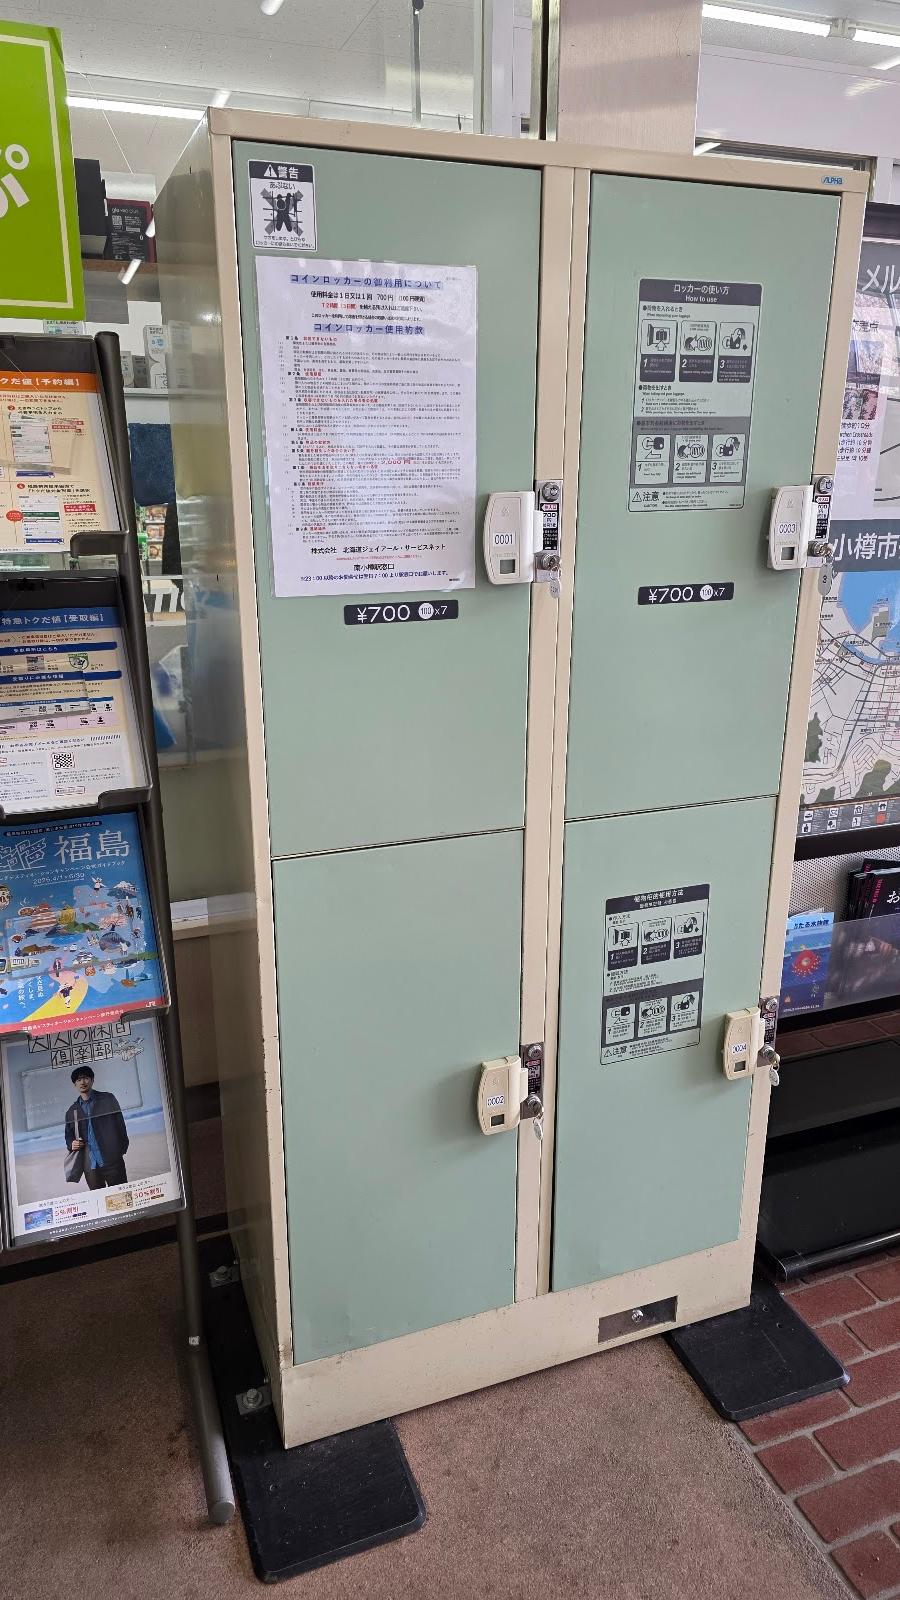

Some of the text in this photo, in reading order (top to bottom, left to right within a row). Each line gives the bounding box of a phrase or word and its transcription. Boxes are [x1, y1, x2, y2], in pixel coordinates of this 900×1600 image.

[278, 166, 299, 180] 警告
[823, 176, 843, 184] ALPHA
[269, 182, 296, 190] あぶない
[290, 274, 442, 290] コインロッカーの御利用について
[674, 284, 730, 295] ロッカーの使い方
[314, 323, 424, 335] コインロッカー使用約款
[643, 358, 648, 367] 1
[682, 358, 687, 367] 2
[720, 360, 725, 369] 3
[638, 463, 642, 471] 1
[675, 462, 680, 471] 2
[712, 462, 717, 471] 3
[643, 491, 660, 501] 注意
[779, 524, 796, 533] 0003
[494, 534, 513, 544] 0001
[832, 532, 900, 561] 小樽市
[822, 574, 827, 583] 3
[648, 586, 693, 603] ¥700
[356, 604, 411, 624] ¥700
[2, 614, 104, 626] 特急トクだ値【受取編】
[53, 829, 130, 864] 福島
[886, 890, 900, 904] お
[31, 1024, 130, 1051] 大人の休日
[52, 1043, 112, 1067] 倶楽部
[487, 1096, 504, 1106] 0002
[54, 1206, 79, 1217] 5%割引
